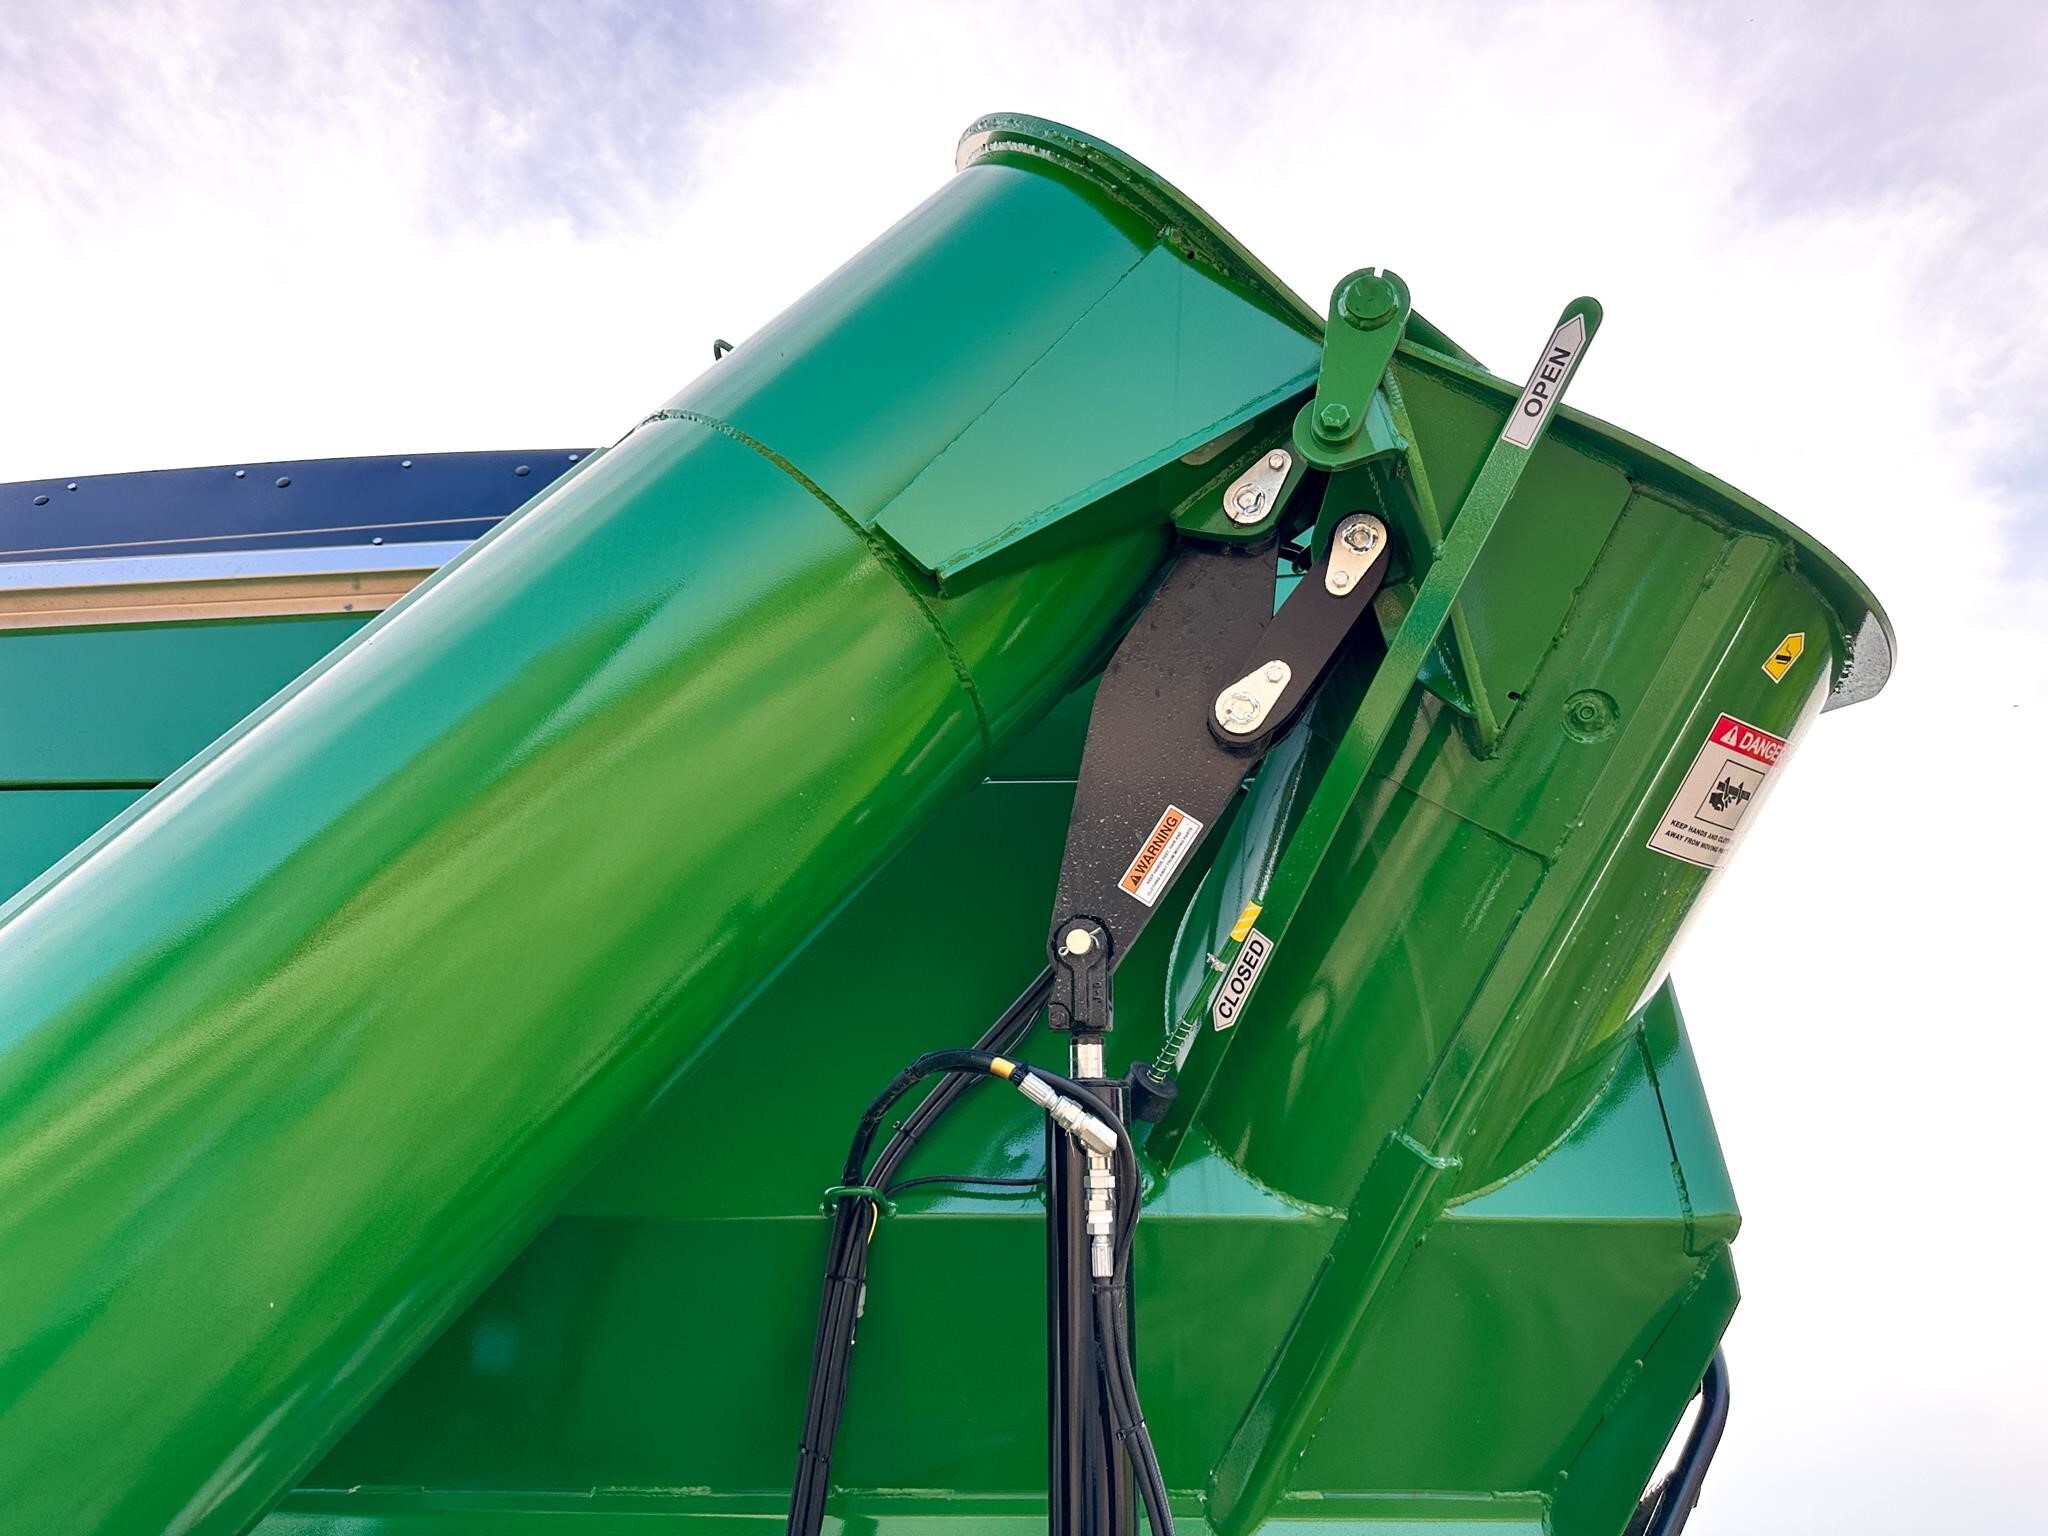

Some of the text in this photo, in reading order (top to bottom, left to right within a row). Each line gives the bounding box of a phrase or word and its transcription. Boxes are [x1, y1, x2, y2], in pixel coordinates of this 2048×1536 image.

[1524, 346, 1571, 417] OPEN
[1135, 816, 1178, 875] WARNING
[1665, 830, 1685, 841] AWAY
[1684, 837, 1701, 847] FROM
[1670, 819, 1689, 830] KEEP
[1688, 826, 1708, 838] HANDS
[1219, 940, 1264, 1019] CLOSED
